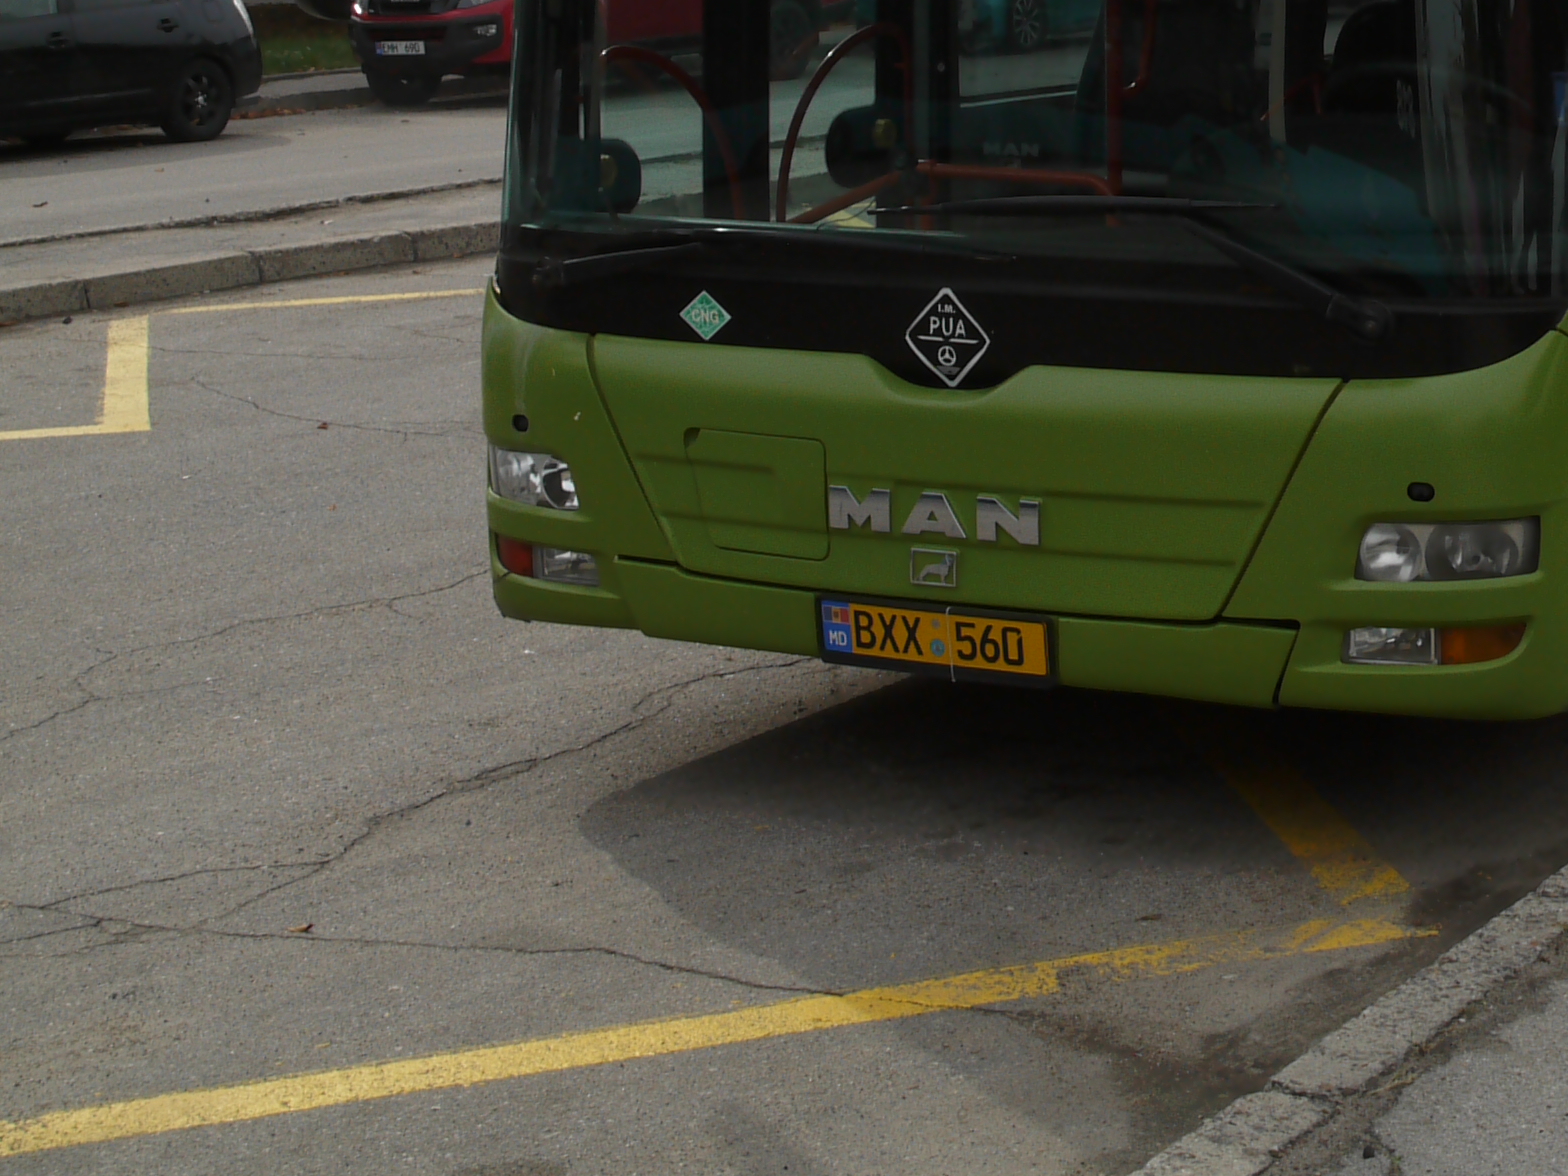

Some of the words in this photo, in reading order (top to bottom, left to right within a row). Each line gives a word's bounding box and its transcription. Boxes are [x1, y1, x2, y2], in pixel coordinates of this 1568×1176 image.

[691, 308, 721, 326] CNG
[929, 315, 967, 338] PUA
[828, 485, 1041, 546] MAN
[828, 629, 848, 647] MD
[853, 609, 924, 657] BXX
[955, 622, 1025, 667] 560
